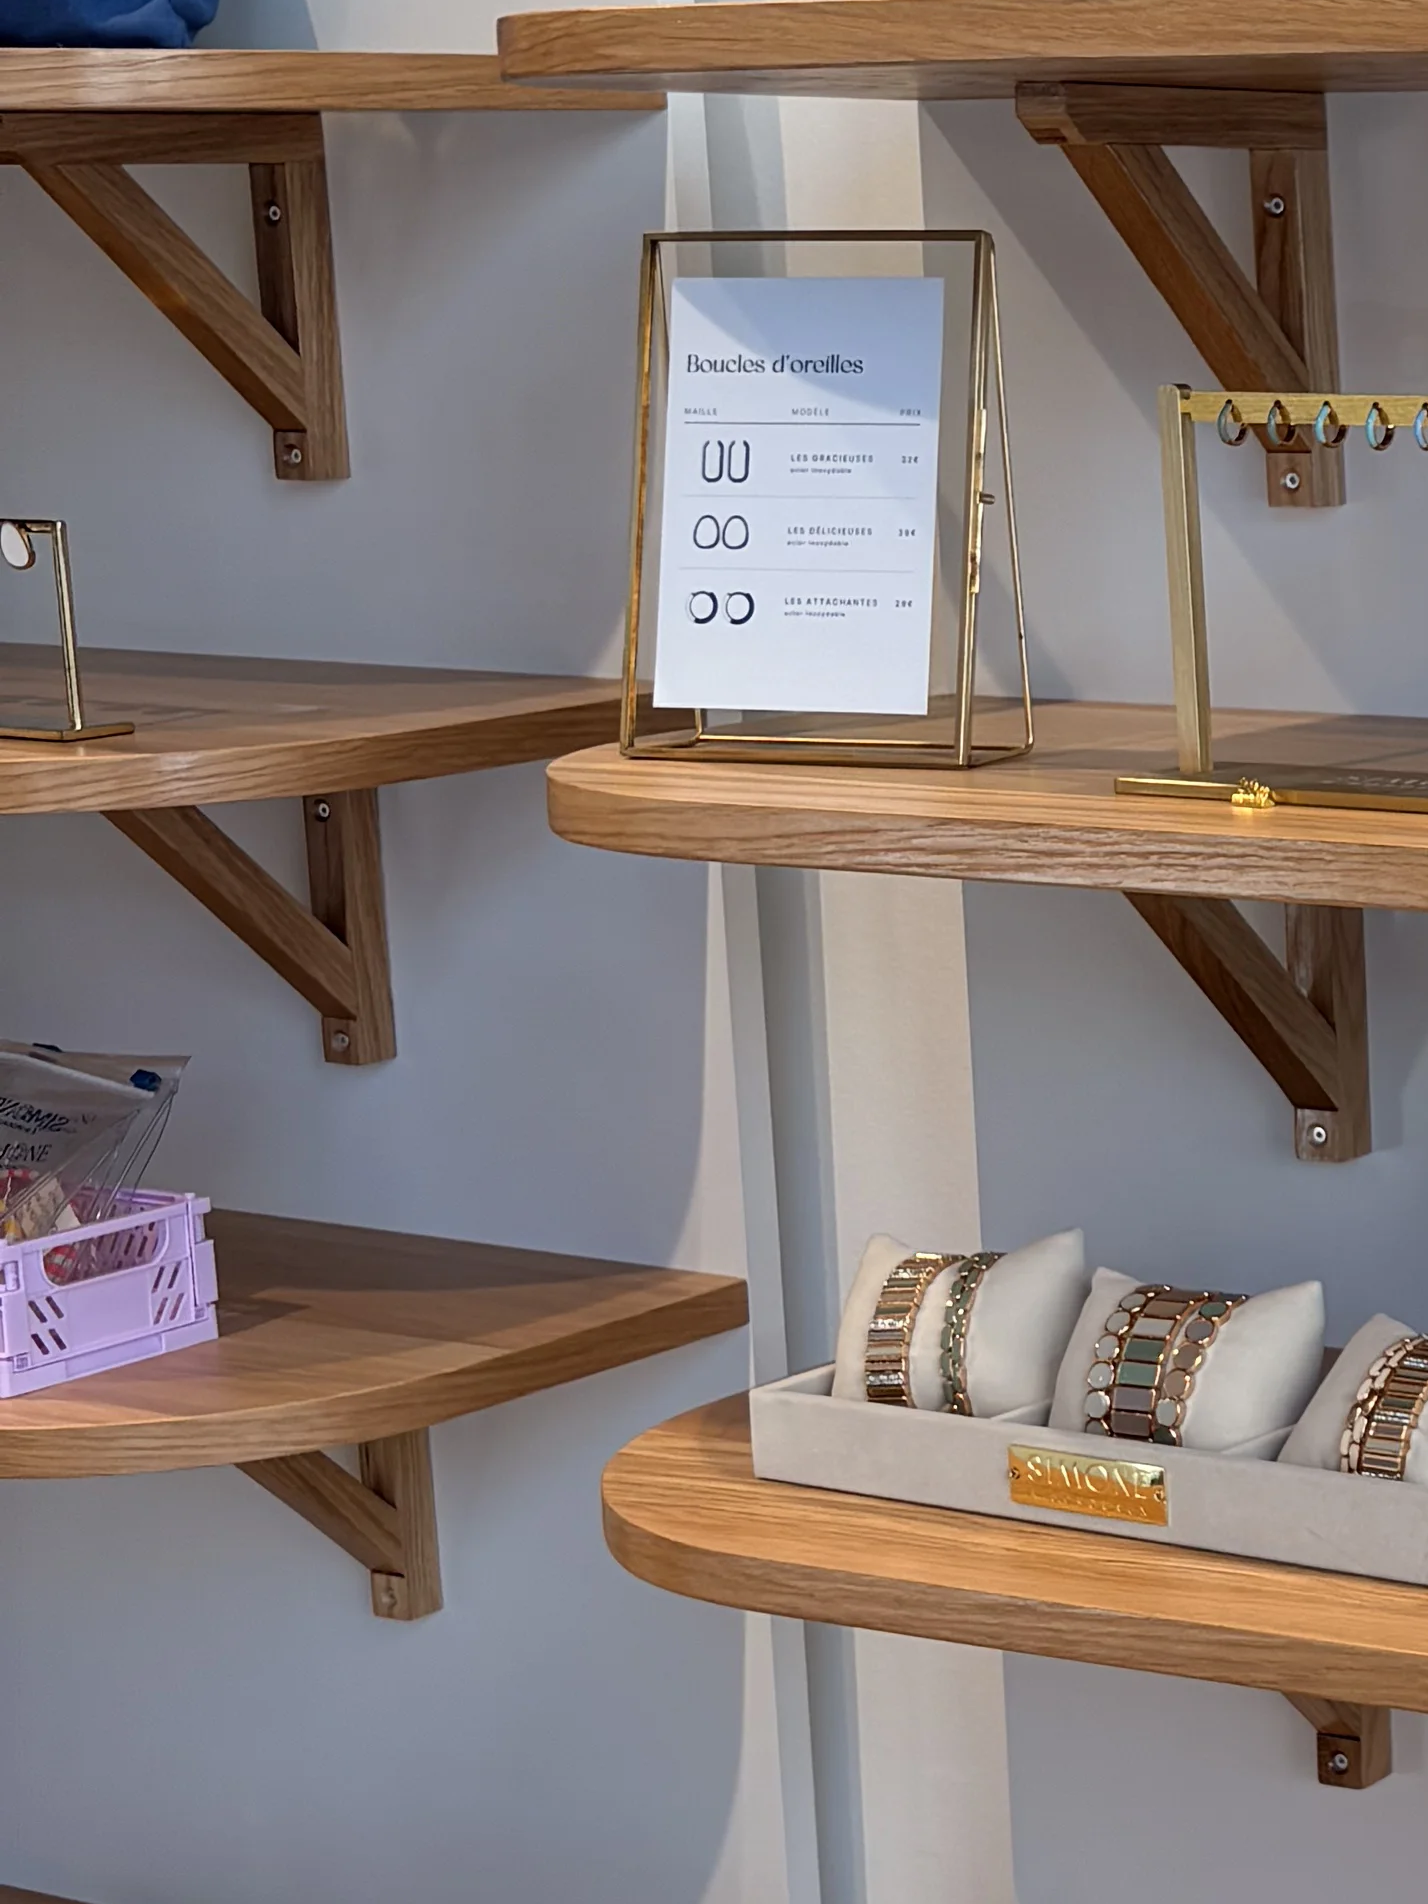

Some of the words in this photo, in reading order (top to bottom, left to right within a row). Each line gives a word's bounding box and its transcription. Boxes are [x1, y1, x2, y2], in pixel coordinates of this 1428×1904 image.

[686, 354, 766, 374] Boucles
[772, 354, 864, 375] d'oreilles
[790, 454, 808, 462] LES
[812, 454, 874, 463] GRACIEUSES
[787, 526, 805, 535] LES
[809, 525, 873, 536] DÉLICIEUSES
[785, 597, 802, 606] LES
[806, 598, 878, 607] ATTACHANTES
[1026, 1453, 1147, 1500] SIMONE
